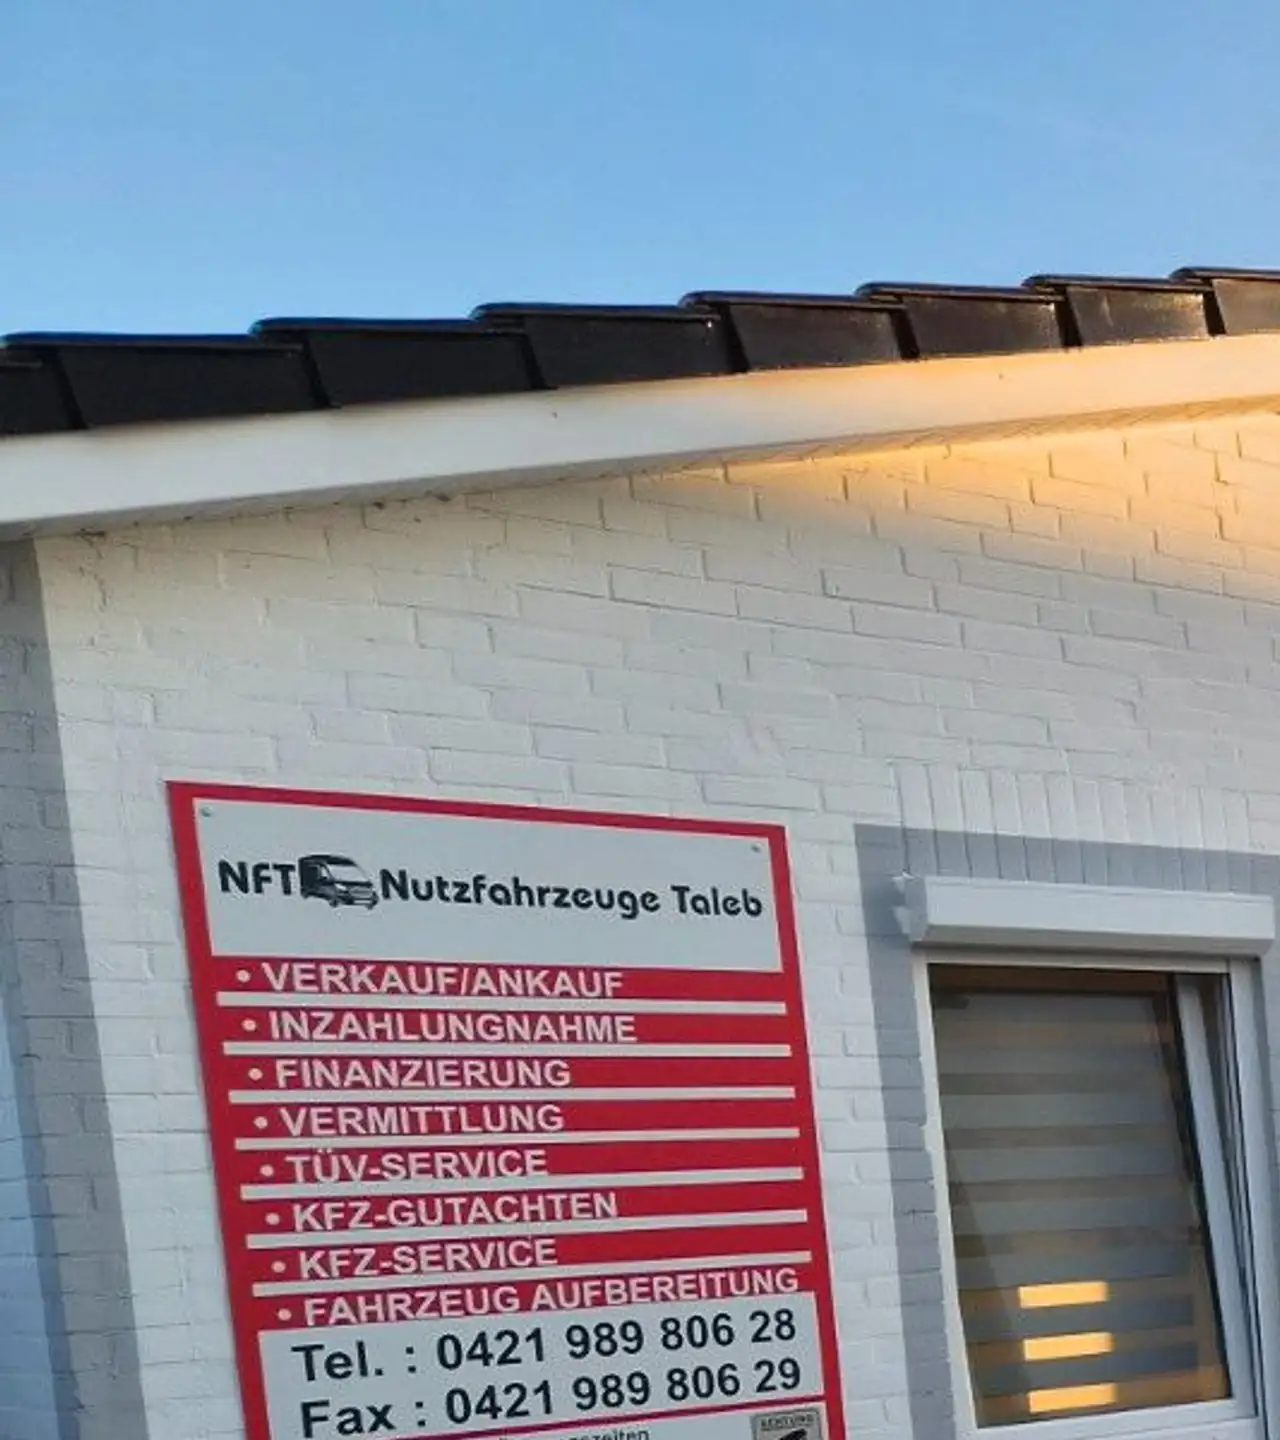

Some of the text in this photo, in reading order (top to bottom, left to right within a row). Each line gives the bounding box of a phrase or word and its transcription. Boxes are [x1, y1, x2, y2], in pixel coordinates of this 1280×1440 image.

[218, 859, 763, 920] NFT Nutzfahrzeuge Taleb
[262, 962, 623, 998] VERKAUF/ANKAUF
[269, 1010, 637, 1044] INZAHLUNGNAHME
[275, 1059, 571, 1089] FINANZIERUNG
[280, 1104, 565, 1137] VERMITTLUNG
[286, 1148, 548, 1183] TÜV-SERVICE
[293, 1191, 619, 1232] KFZ-GUTACHTEN
[300, 1238, 558, 1280] KFZ-SERVICE
[303, 1267, 798, 1326] FAHRZEUG AUFBEREITUNG
[291, 1340, 384, 1382] Tel.
[436, 1327, 545, 1371] 0421
[565, 1320, 644, 1359] 989
[660, 1312, 735, 1350] 806
[750, 1308, 796, 1343] 28
[300, 1400, 397, 1439] Fax
[446, 1380, 553, 1424] 0421
[572, 1371, 650, 1410] 989
[666, 1363, 740, 1401] 806
[753, 1357, 801, 1394] 29
